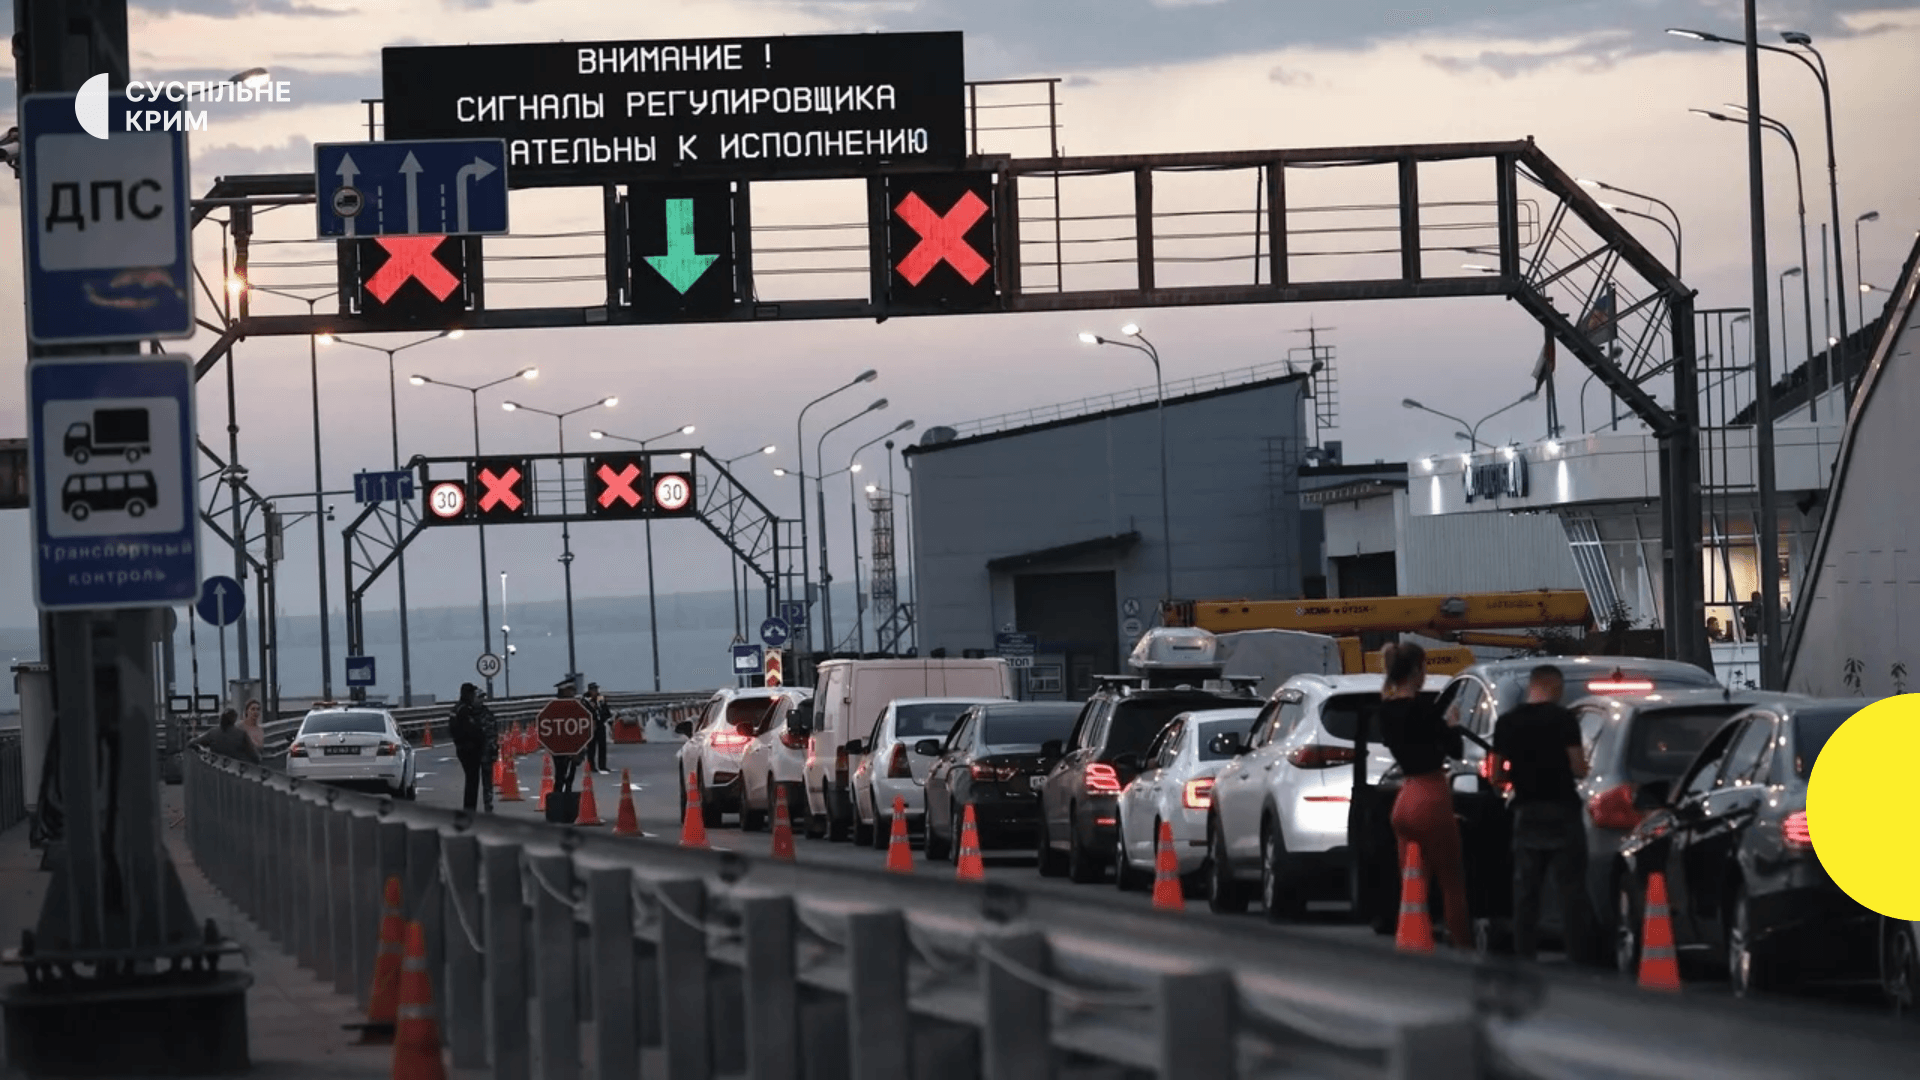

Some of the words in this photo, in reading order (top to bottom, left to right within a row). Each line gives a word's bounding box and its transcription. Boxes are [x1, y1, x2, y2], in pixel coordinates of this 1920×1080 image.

[578, 44, 743, 74] ВНИМАНИЕ
[764, 43, 771, 69] !
[457, 92, 604, 122] СИГНАЛЫ
[626, 84, 896, 118] РЕГУЛИРОВЩИКА
[510, 136, 656, 166] АТЕЛЬНЫ
[678, 135, 698, 160] К
[720, 127, 929, 160] ИСПОЛНЕНИЮ
[45, 179, 163, 233] ДПС
[437, 491, 457, 509] 30
[662, 484, 682, 501] 30
[42, 540, 193, 562] Транспортный
[68, 569, 166, 587] контроль
[481, 659, 496, 671] 30
[540, 717, 590, 736] STOP
